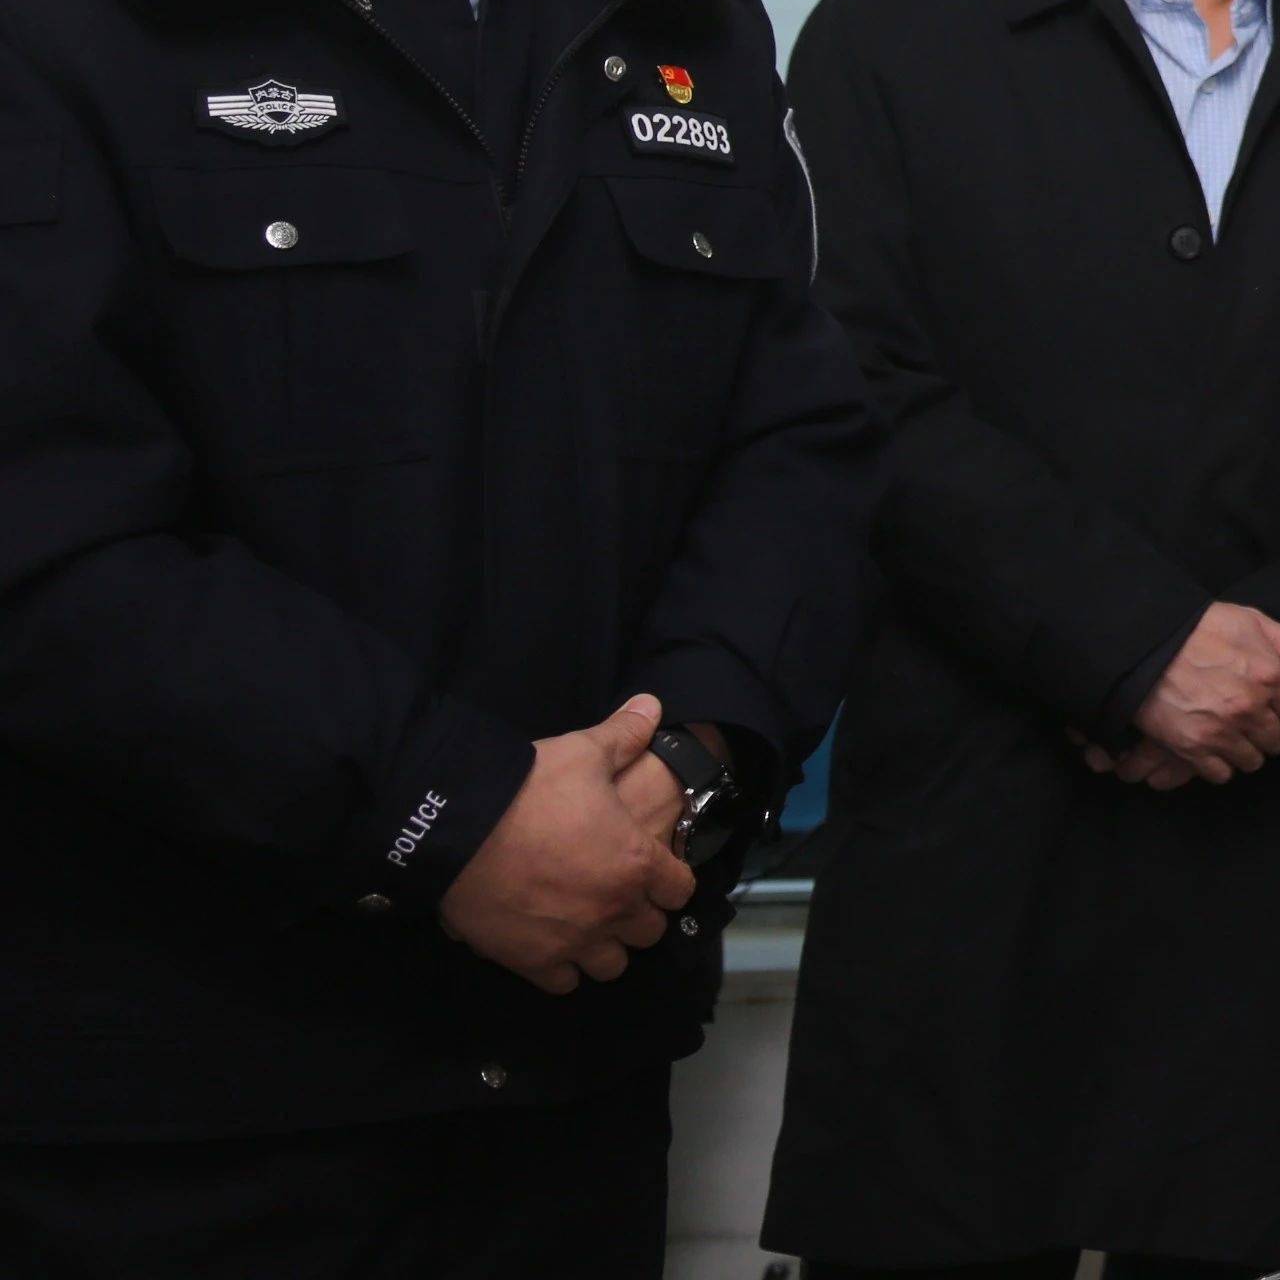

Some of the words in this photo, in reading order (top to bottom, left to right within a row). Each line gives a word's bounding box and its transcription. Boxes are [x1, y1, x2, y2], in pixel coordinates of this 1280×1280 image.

[259, 102, 297, 113] POLICE
[631, 113, 731, 154] 022893
[388, 790, 447, 867] POLICE
